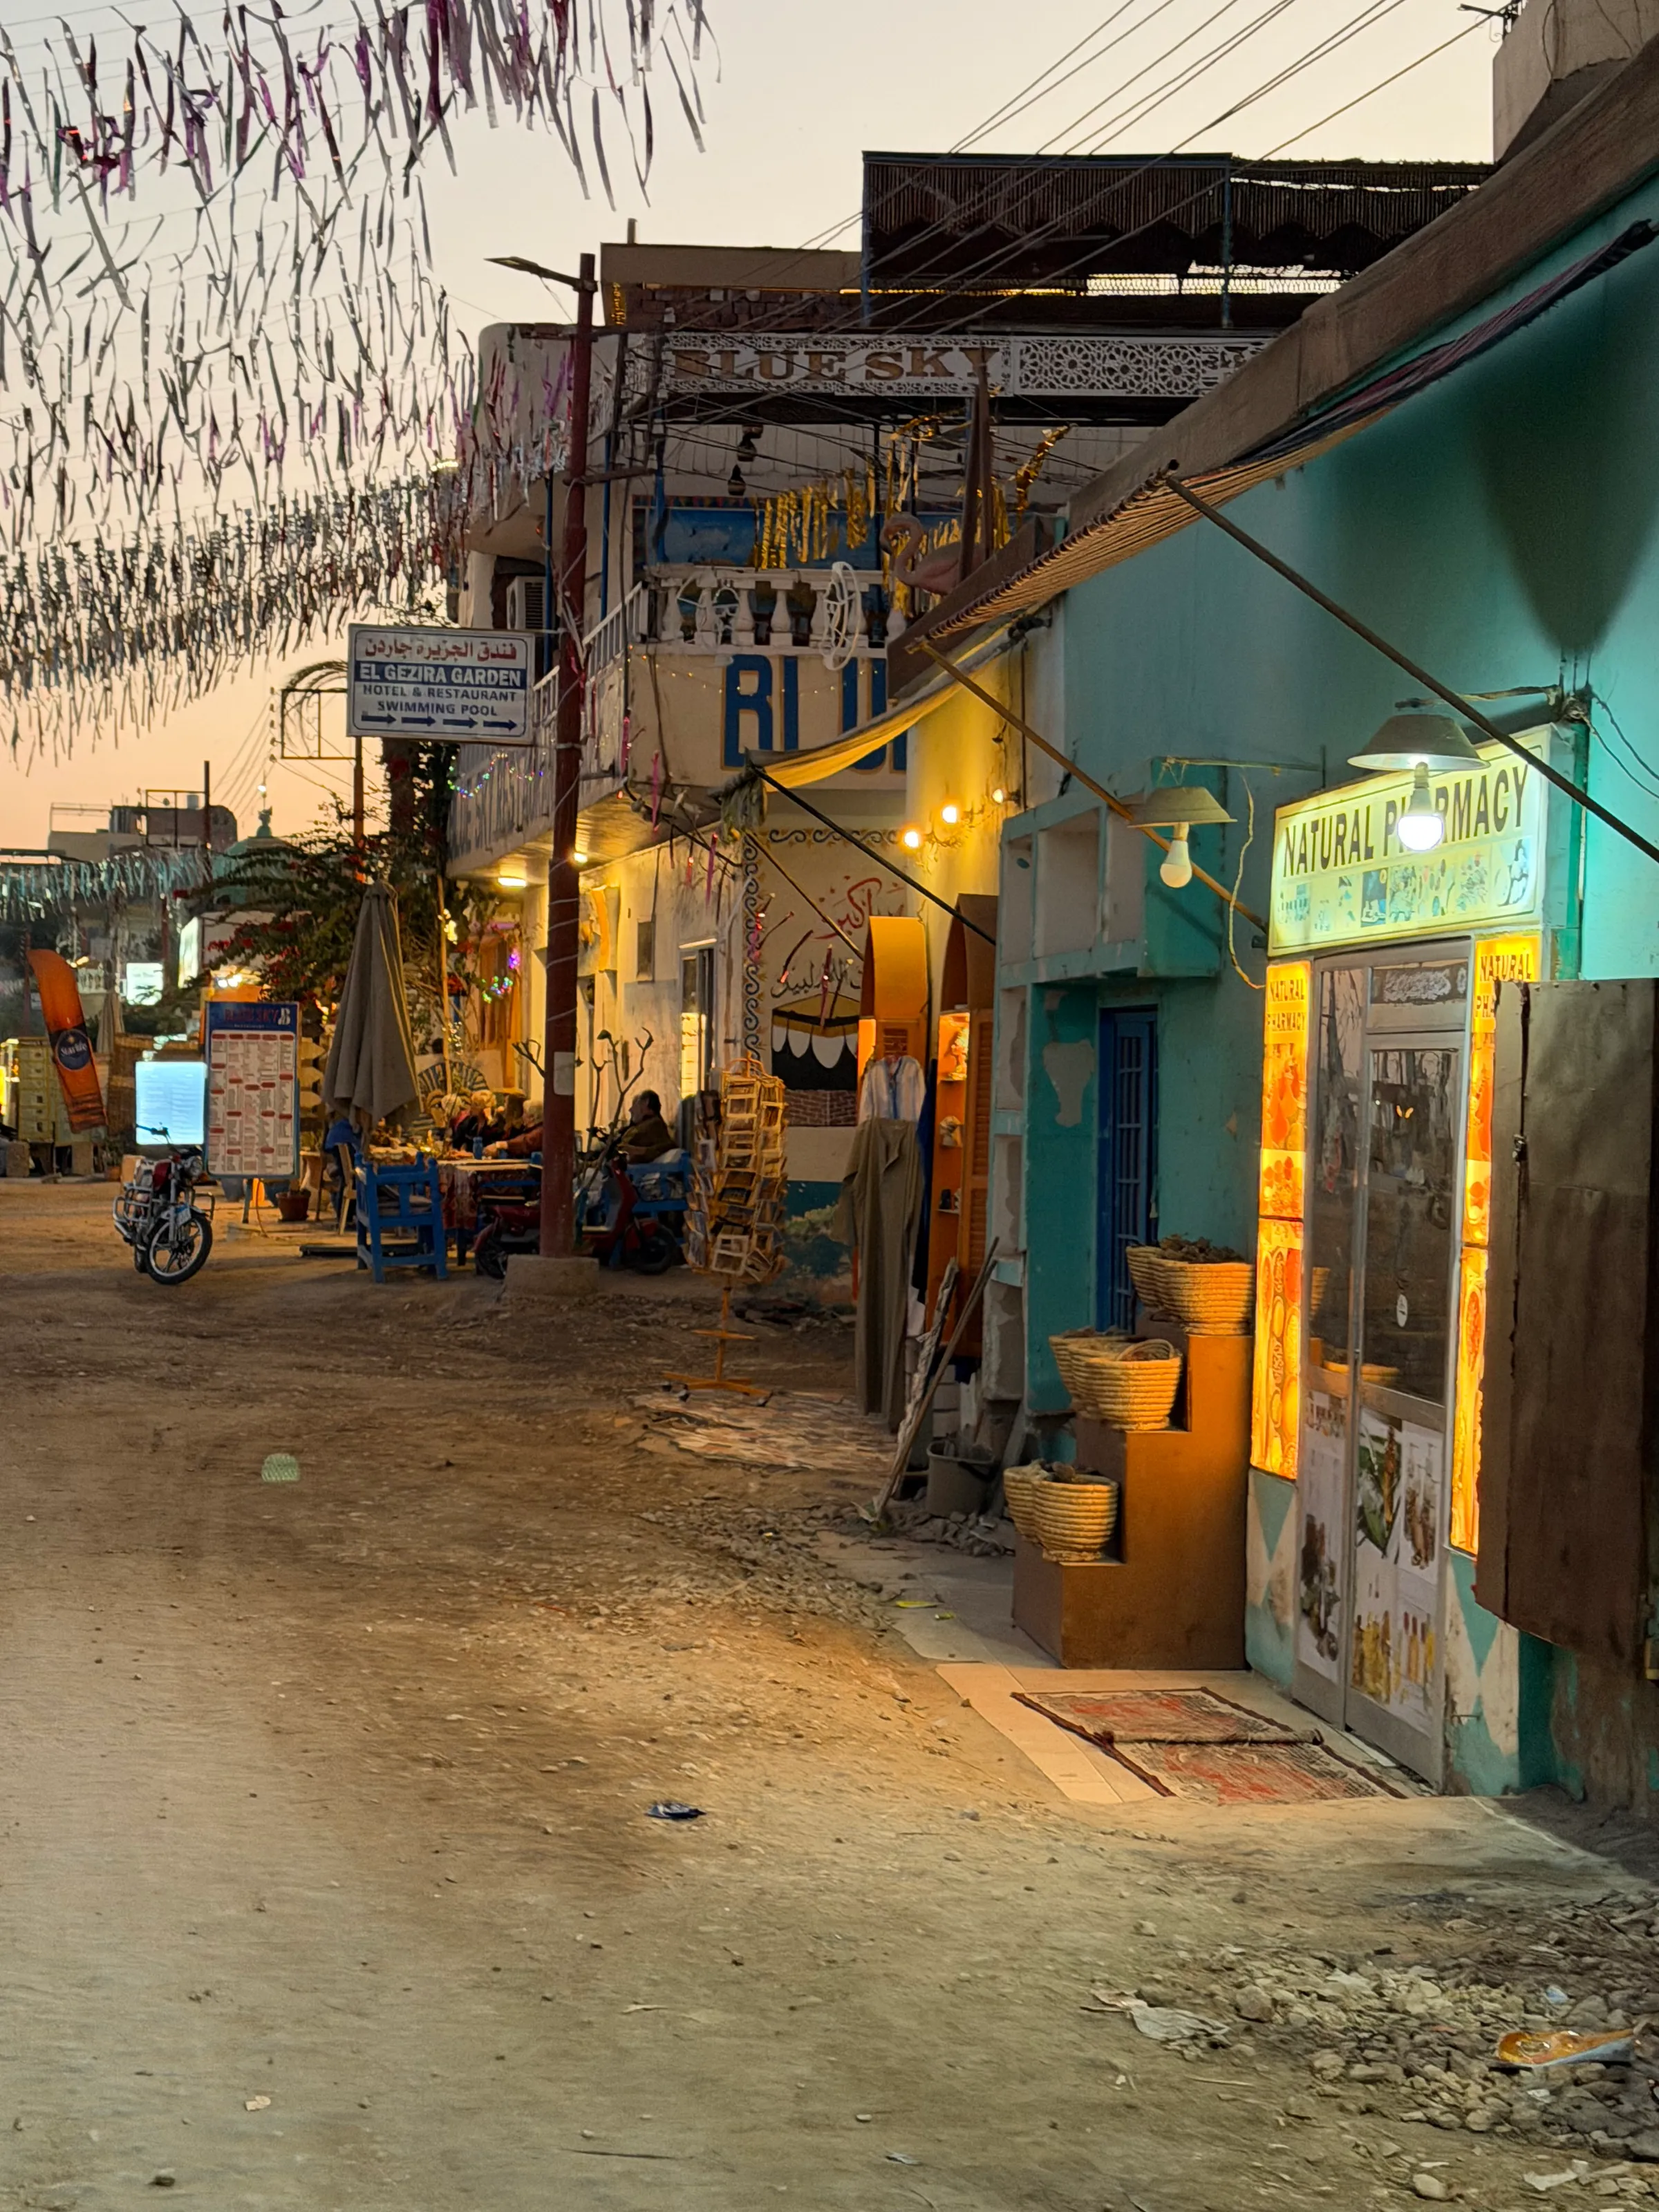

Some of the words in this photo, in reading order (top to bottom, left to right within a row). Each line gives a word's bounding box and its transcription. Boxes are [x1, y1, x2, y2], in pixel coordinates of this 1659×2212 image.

[672, 349, 847, 382] BLUE
[865, 346, 1000, 381] SKY
[365, 638, 412, 659] جاردن
[416, 638, 474, 662] الجزيرة
[477, 641, 517, 662] فندق
[359, 663, 379, 680] EL
[384, 664, 447, 684] GEZIRA
[451, 667, 521, 686] GARDEN
[363, 684, 407, 697] HOTEL
[413, 686, 422, 697] &
[427, 686, 517, 702] RESTAURANT
[377, 700, 455, 715] SWIMMING
[461, 704, 498, 716] POOL
[1283, 804, 1374, 878] NATURAL
[1383, 764, 1528, 856] PRMACY
[1479, 953, 1531, 982] NATURAL
[1269, 978, 1304, 1002] NATURAL
